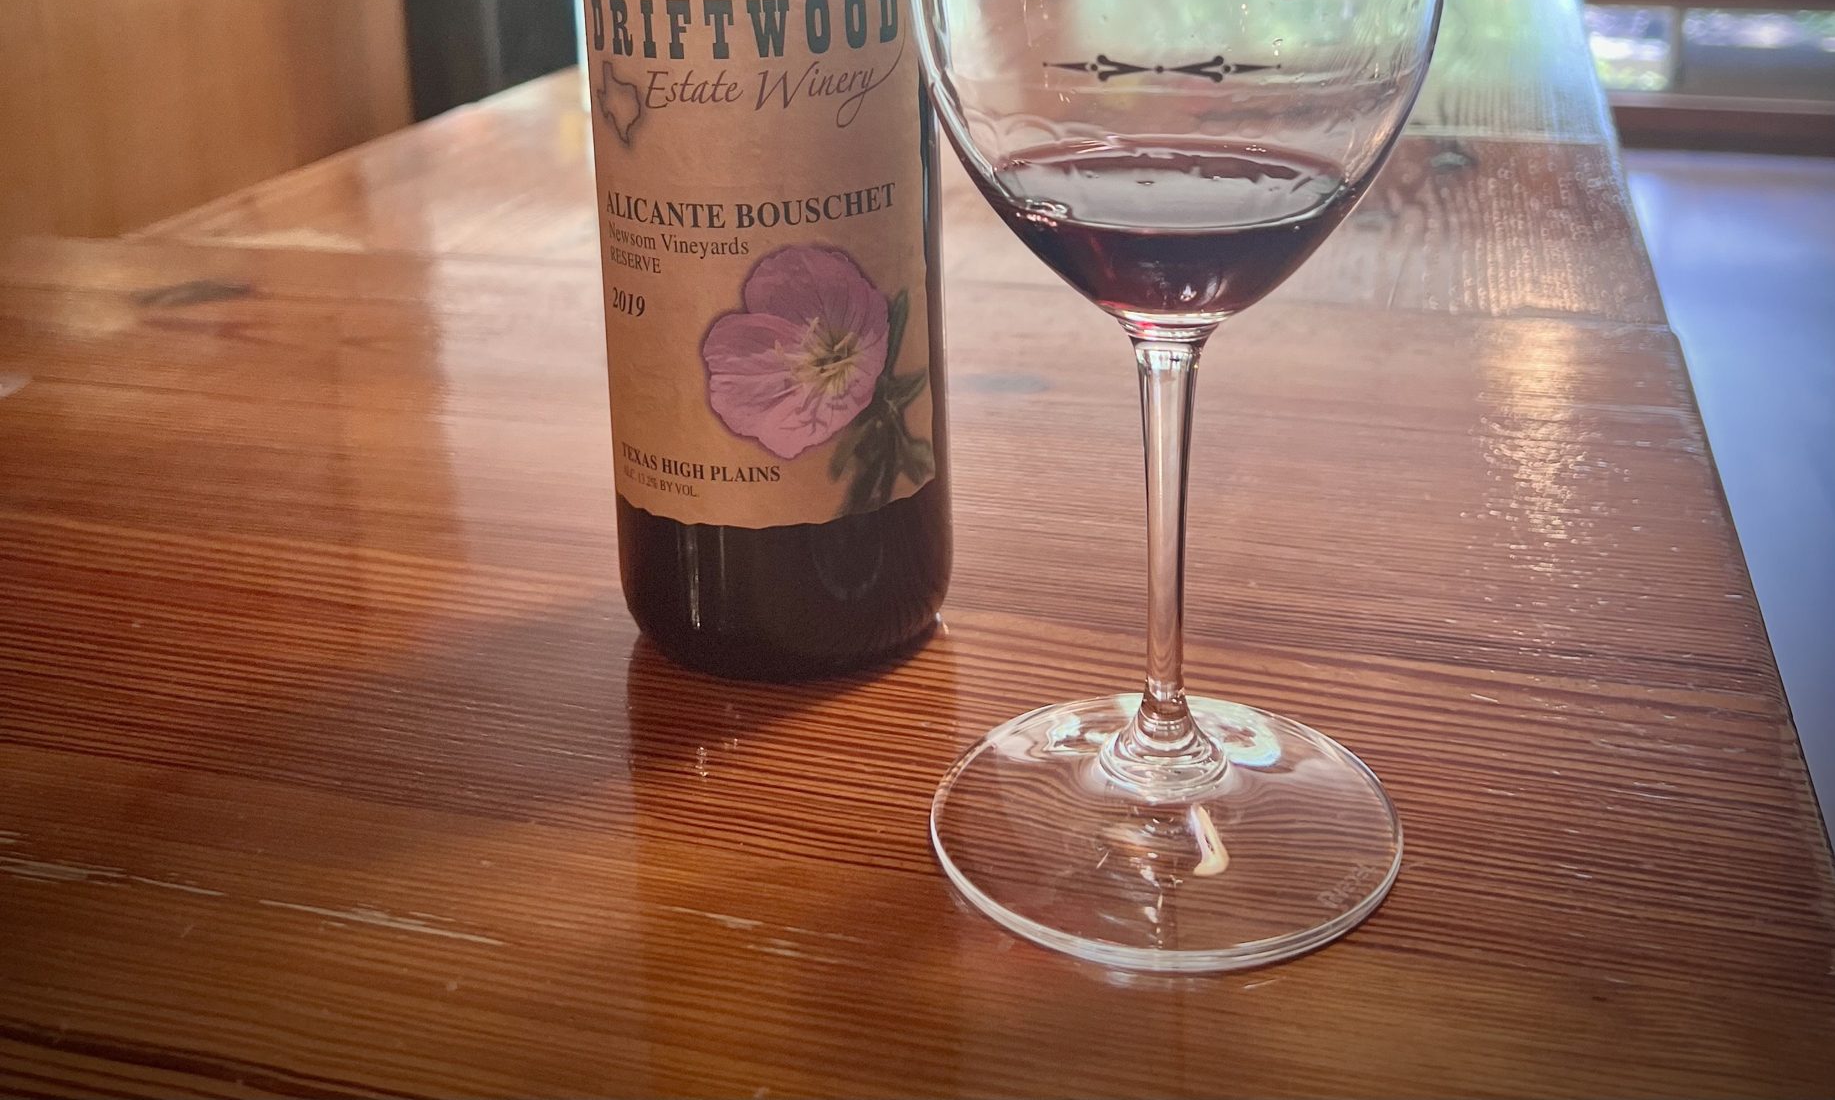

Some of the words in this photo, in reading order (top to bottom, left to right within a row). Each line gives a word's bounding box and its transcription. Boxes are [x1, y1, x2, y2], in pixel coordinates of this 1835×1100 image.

[645, 69, 743, 109] Estate
[755, 60, 893, 128] Winery
[605, 190, 726, 229] ALICANTE
[735, 182, 896, 229] BOUSCHET
[608, 221, 657, 250] Newsom
[660, 233, 750, 259] Vineyards
[610, 246, 662, 274] RESERVE
[612, 286, 646, 317] 2019
[621, 441, 658, 471] TEXAS
[662, 457, 705, 481] HIGH
[711, 465, 781, 483] PLAINS
[660, 479, 673, 492] BY
